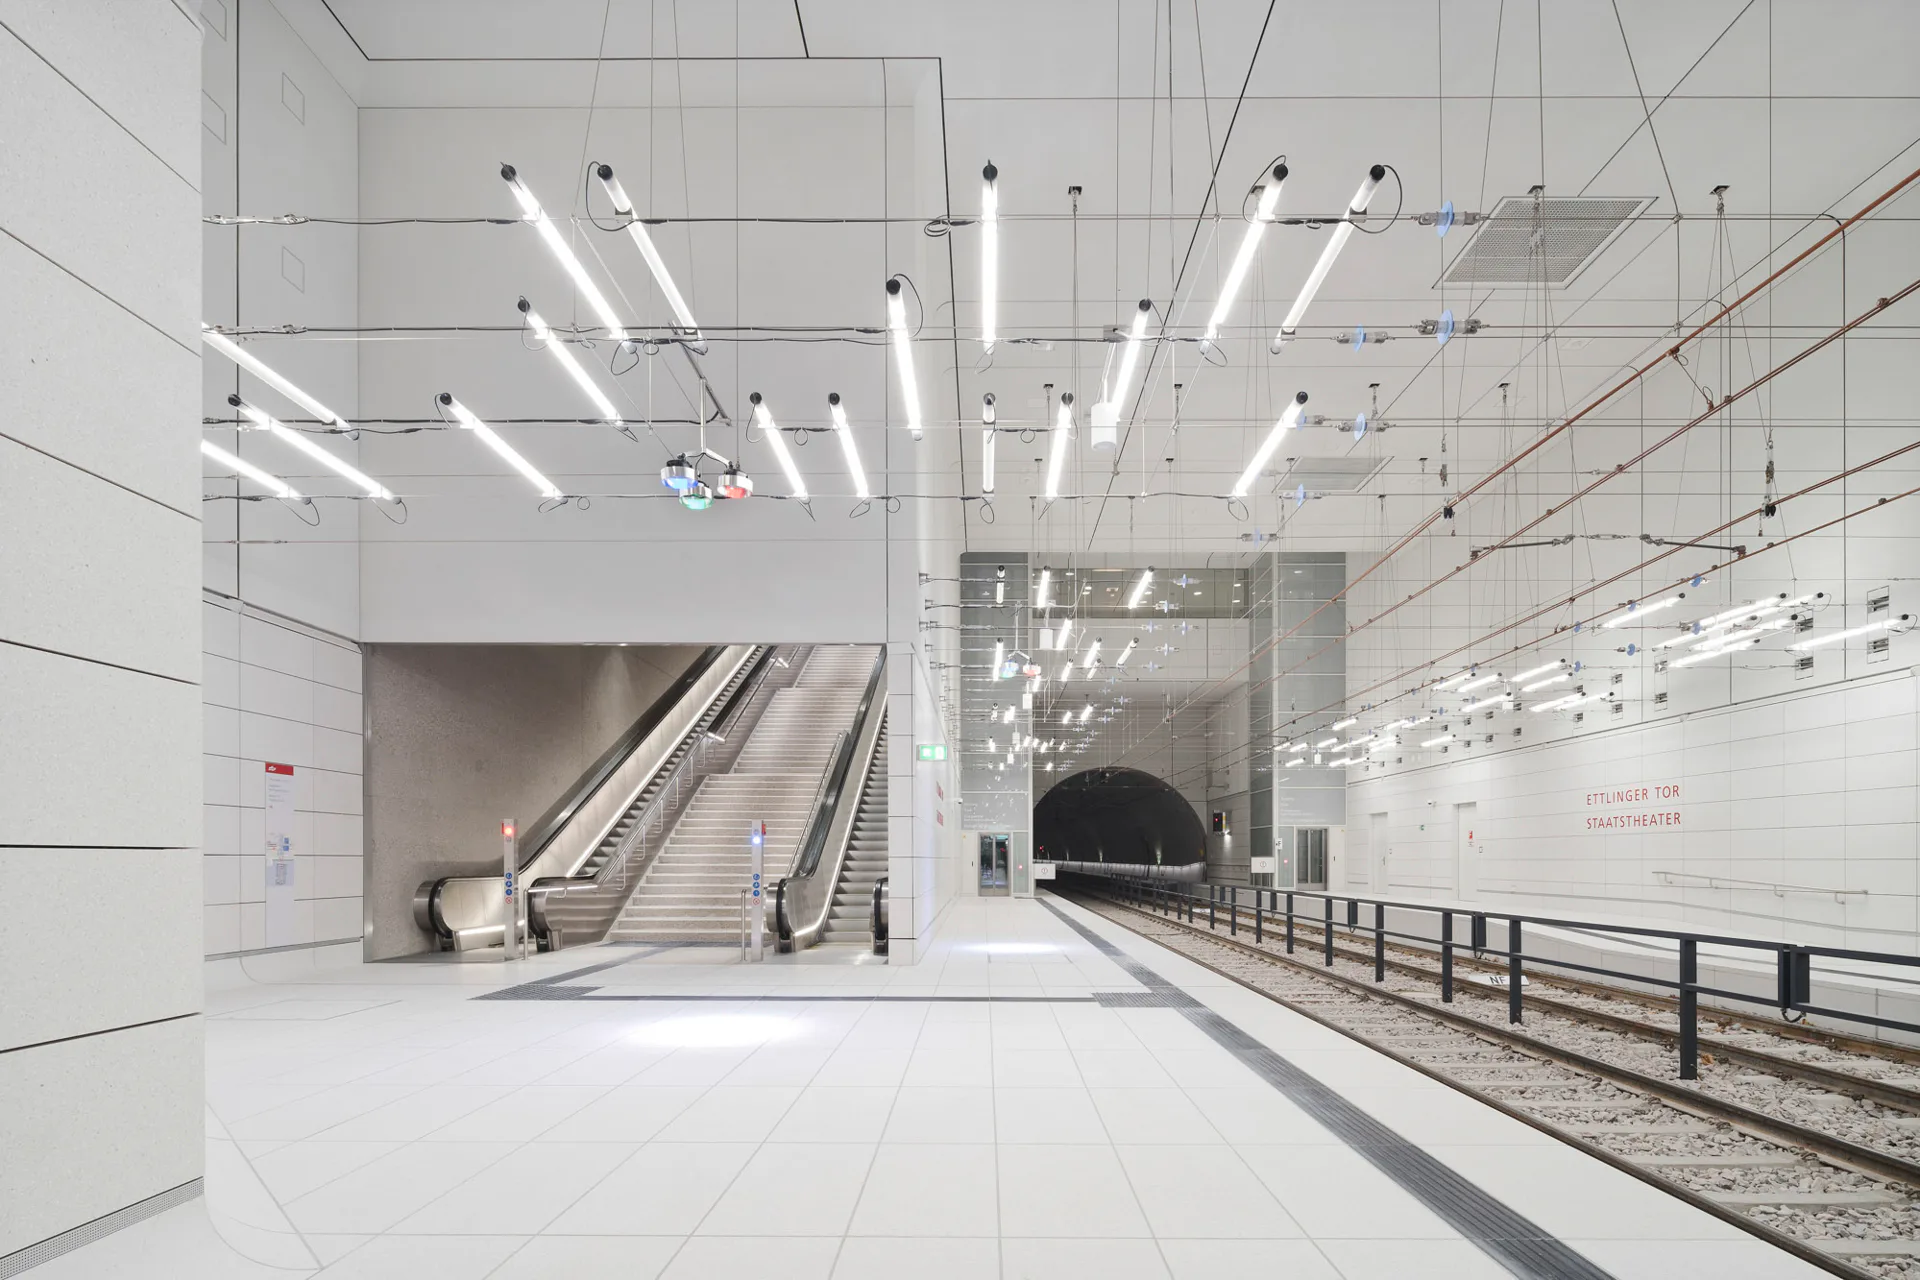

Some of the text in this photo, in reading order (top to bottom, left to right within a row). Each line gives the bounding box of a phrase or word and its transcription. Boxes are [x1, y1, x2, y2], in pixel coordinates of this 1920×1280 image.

[1587, 785, 1680, 805] ETTLINGER TOR
[1587, 812, 1681, 829] STAATSTHEATER
